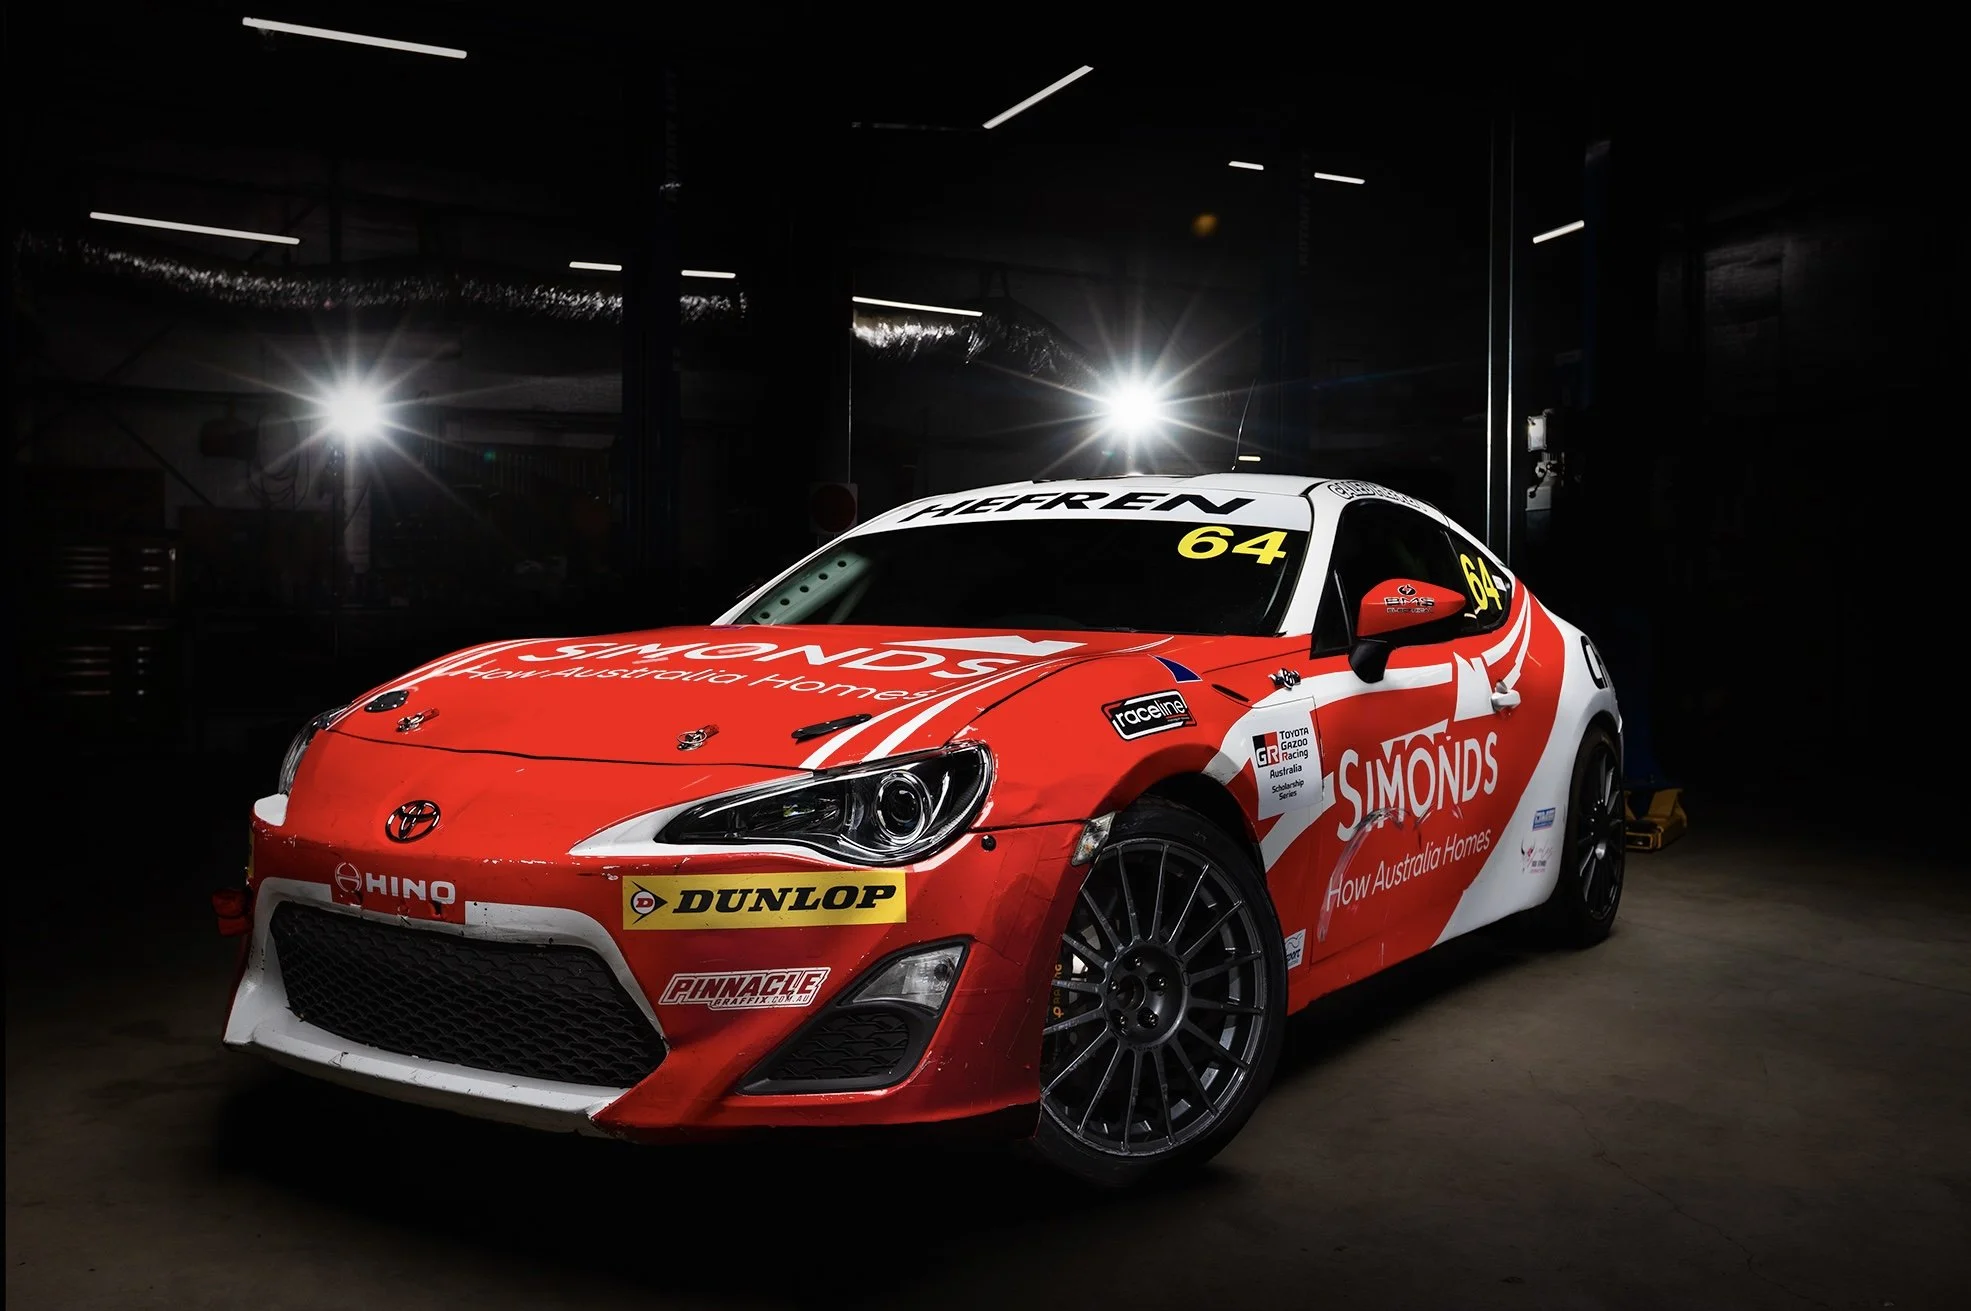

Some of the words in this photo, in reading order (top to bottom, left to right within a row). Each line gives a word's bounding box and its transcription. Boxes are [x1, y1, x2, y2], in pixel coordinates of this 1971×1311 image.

[897, 491, 1256, 524] HEFREN
[1177, 525, 1288, 565] 64
[1460, 553, 1503, 611] 64
[1384, 597, 1435, 607] BMS
[518, 641, 1021, 678] SIMONDS
[449, 659, 550, 680] How
[540, 666, 750, 684] Australia
[748, 673, 938, 701] Homes
[1115, 700, 1186, 728] raceline
[1279, 727, 1309, 740] TOYOTA
[1281, 738, 1308, 751] GAZOO
[1256, 745, 1279, 766] GR
[1282, 749, 1309, 761] Racing
[1270, 763, 1303, 779] Australia
[1272, 779, 1305, 794] Scholarship
[1279, 790, 1298, 801] Series
[1336, 731, 1499, 842] SIMONDS
[1325, 873, 1370, 913] How
[1371, 840, 1442, 895] Australia
[1438, 828, 1492, 866] Homes
[365, 872, 456, 905] HINO
[672, 884, 897, 914] DUNLOP
[668, 970, 822, 1001] PINNACLE
